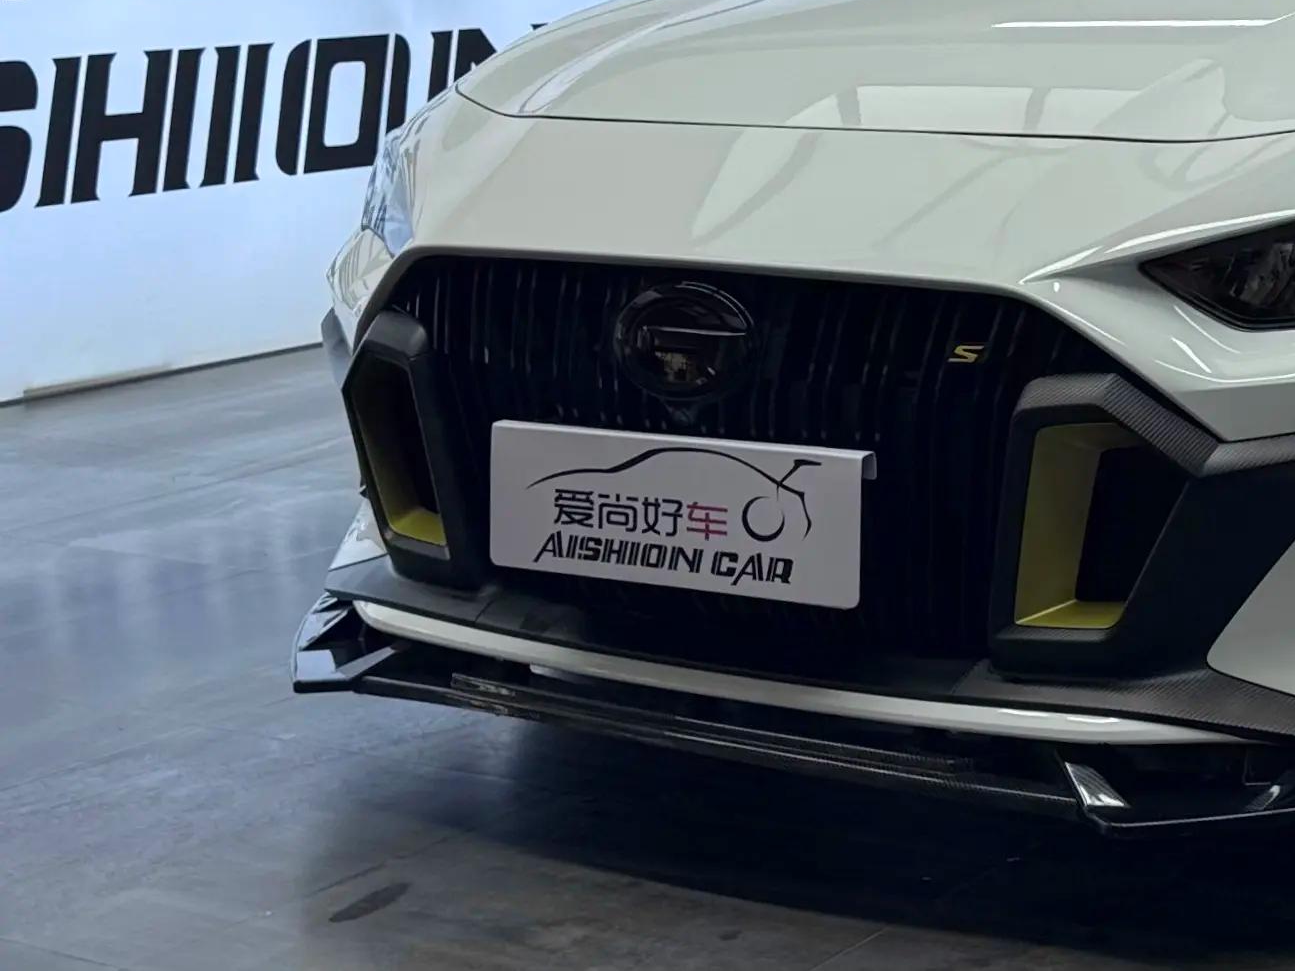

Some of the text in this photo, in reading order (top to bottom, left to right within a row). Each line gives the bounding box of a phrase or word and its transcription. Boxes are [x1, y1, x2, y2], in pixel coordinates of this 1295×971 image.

[0, 22, 549, 213] HIO
[948, 344, 985, 364] S
[553, 487, 728, 540] 爱尚好车
[533, 530, 795, 586] AISHION CAR
